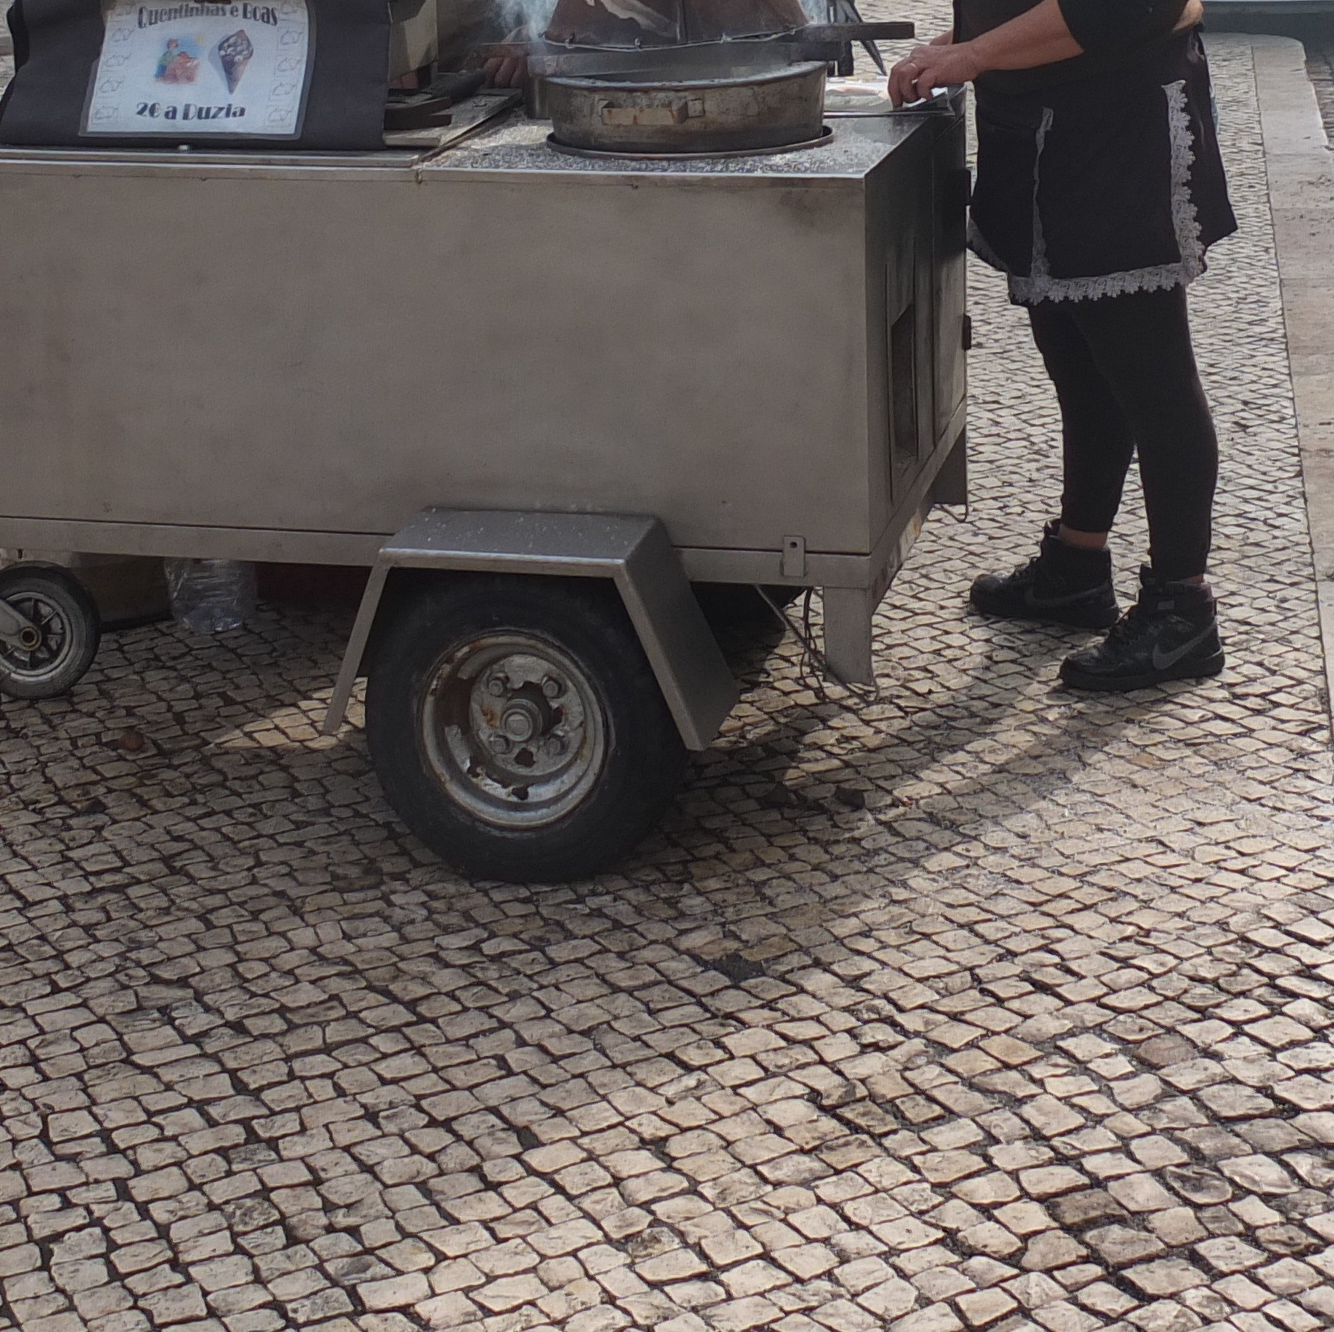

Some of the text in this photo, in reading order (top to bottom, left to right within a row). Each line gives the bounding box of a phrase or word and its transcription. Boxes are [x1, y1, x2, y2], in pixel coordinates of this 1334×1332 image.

[137, 2, 278, 29] Quentinhas e Boas
[164, 104, 178, 120] a
[182, 103, 246, 121] Duzia
